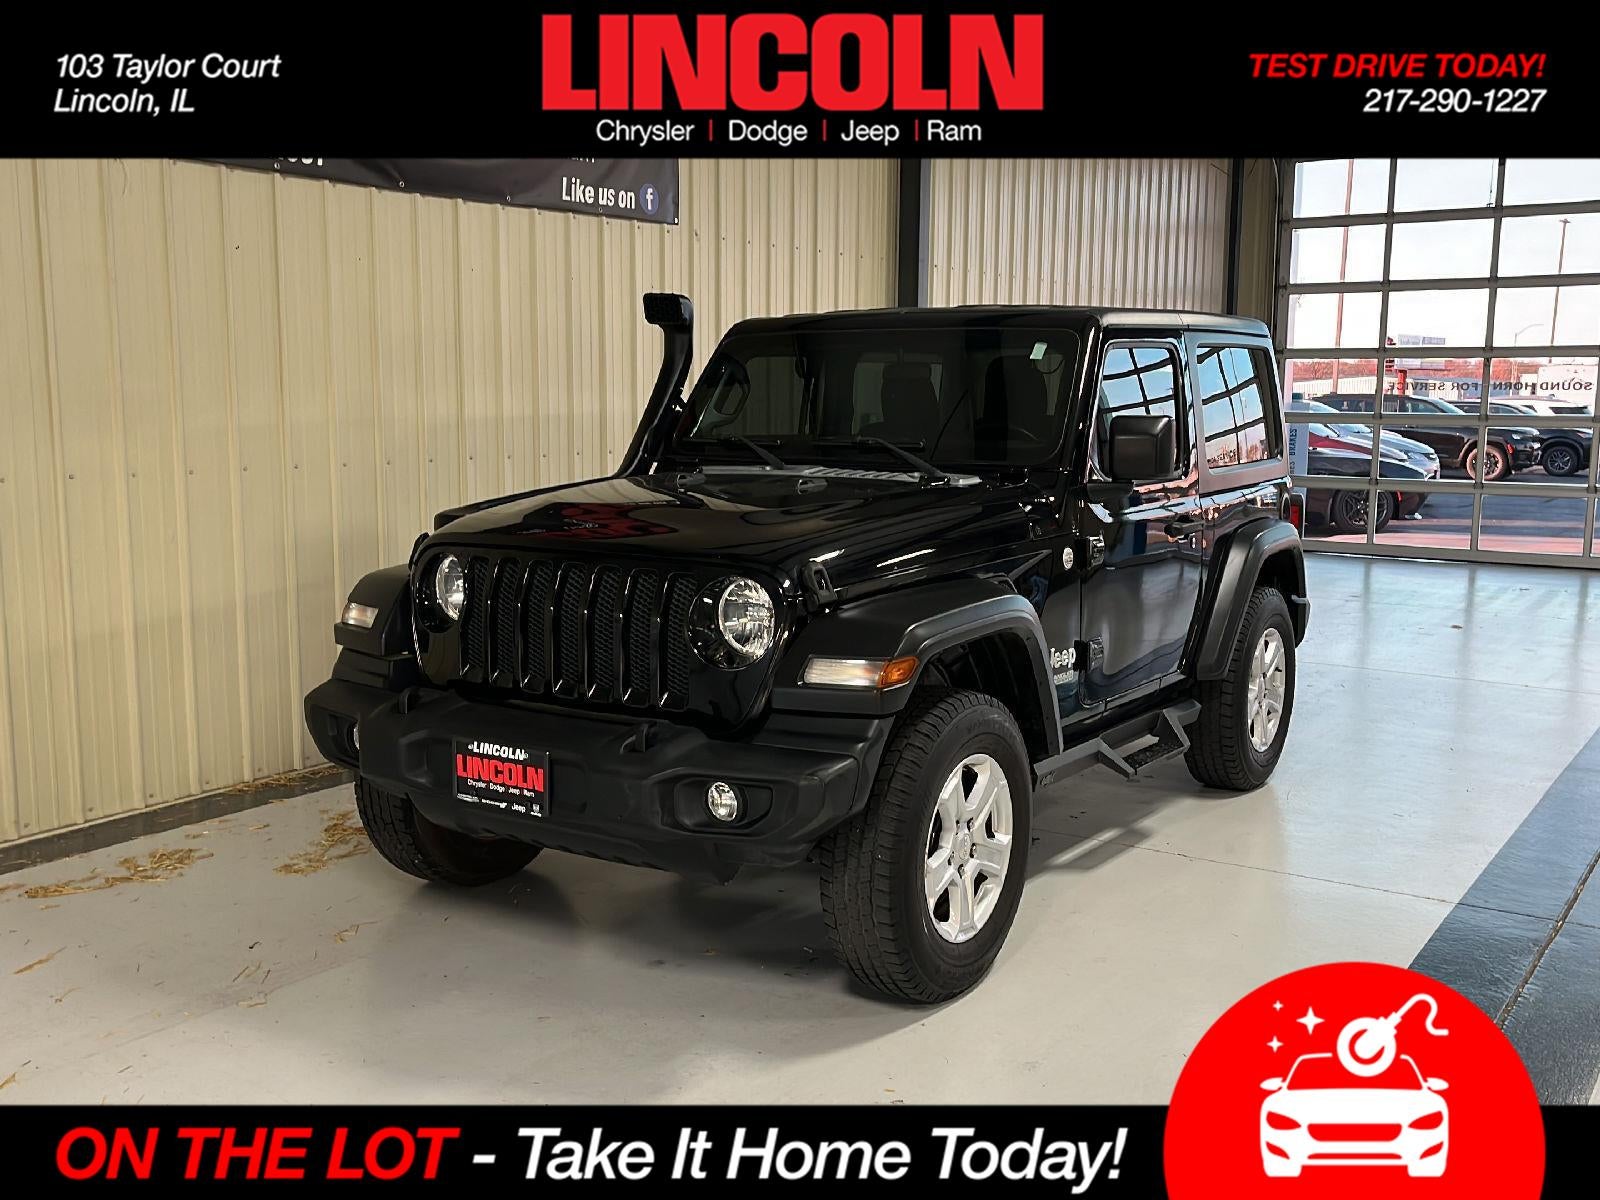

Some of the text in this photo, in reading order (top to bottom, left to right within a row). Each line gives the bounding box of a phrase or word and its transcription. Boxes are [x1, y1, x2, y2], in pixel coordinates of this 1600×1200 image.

[562, 177, 595, 204] Like
[598, 187, 615, 206] us
[618, 190, 636, 209] on
[473, 741, 525, 761] LINCOLN
[456, 754, 544, 793] LINCOLN
